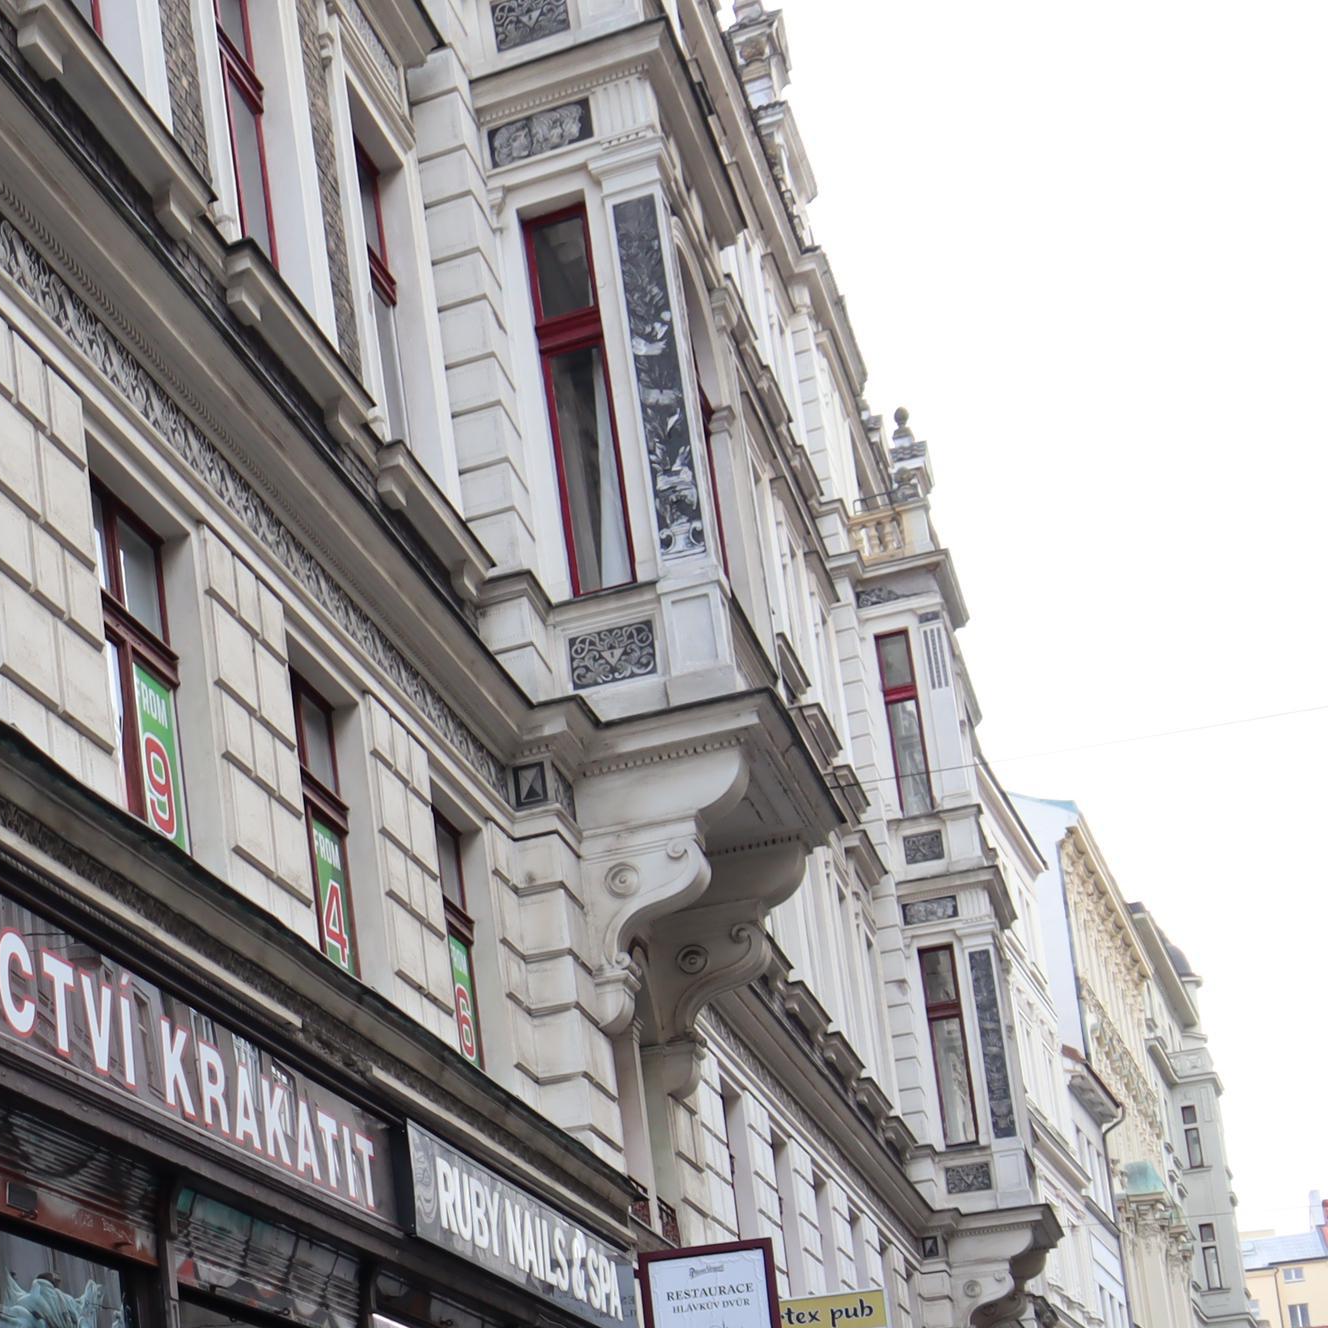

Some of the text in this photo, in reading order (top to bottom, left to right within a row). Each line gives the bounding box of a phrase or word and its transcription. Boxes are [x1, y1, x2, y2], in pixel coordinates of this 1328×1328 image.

[143, 732, 177, 840] 9
[314, 828, 341, 871] FROM
[322, 880, 350, 969] 4
[455, 984, 476, 1062] 6
[159, 1015, 377, 1213] KRAKATIT
[435, 1156, 624, 1322] RUBY NAILS & SPA
[666, 1282, 754, 1301] RESTAURACE
[780, 1299, 874, 1328] tex pub
